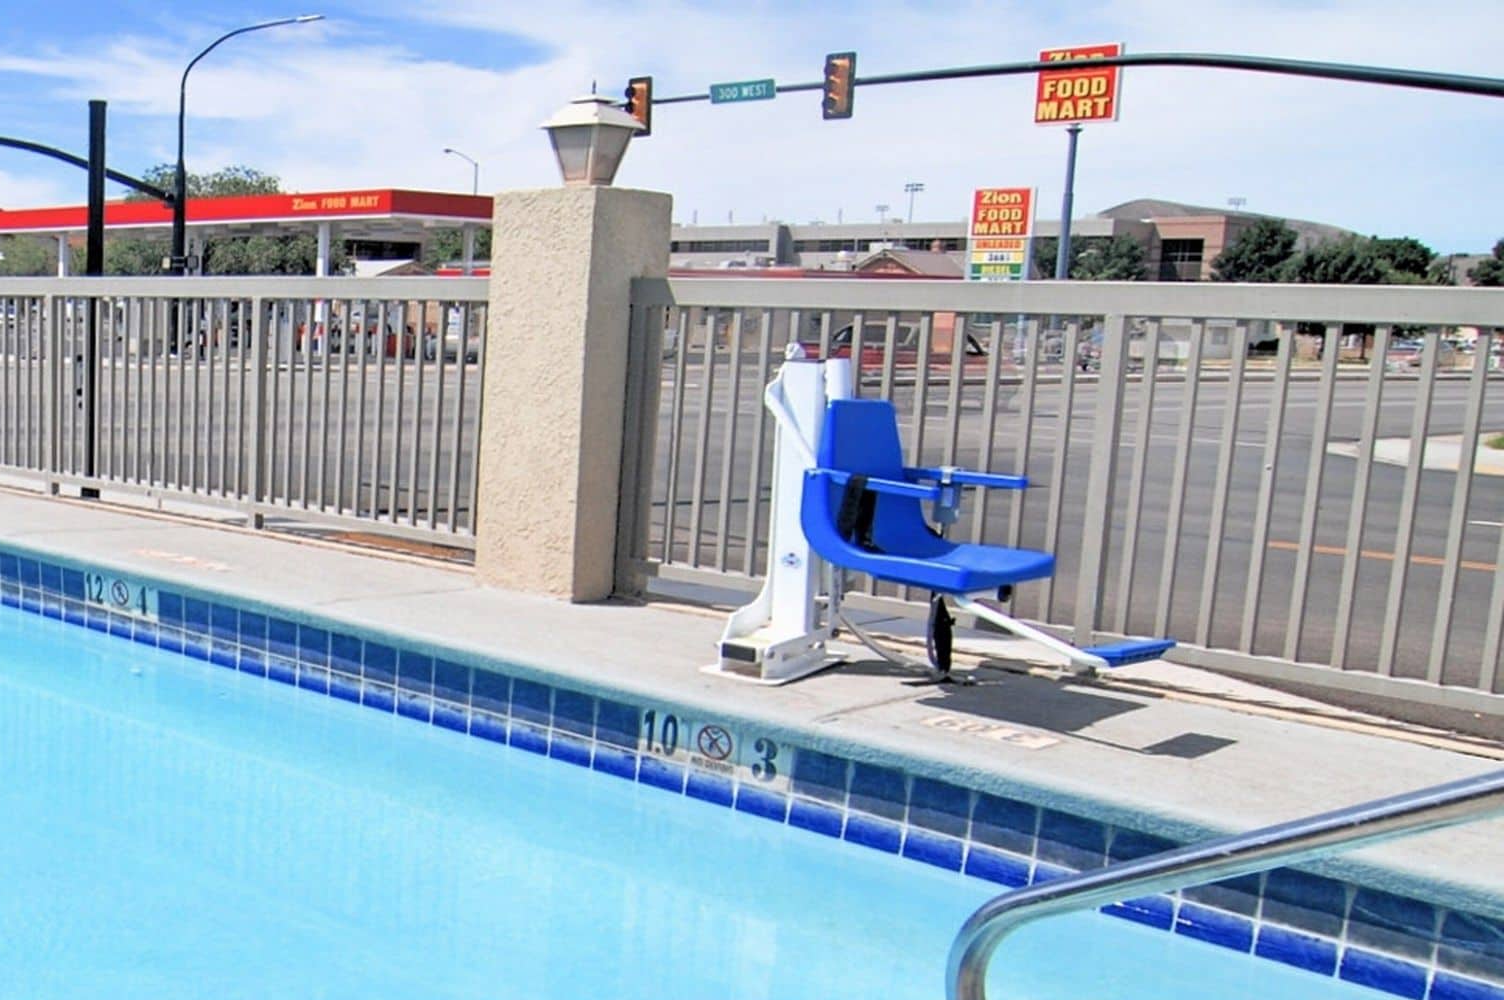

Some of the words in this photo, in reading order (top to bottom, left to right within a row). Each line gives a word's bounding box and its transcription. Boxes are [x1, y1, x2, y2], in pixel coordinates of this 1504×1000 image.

[741, 83, 767, 98] WEST
[1043, 76, 1107, 100] FOOD
[1037, 97, 1110, 120] MART
[321, 197, 347, 209] FOOD
[350, 195, 380, 208] MART
[981, 191, 1022, 205] Zion
[978, 209, 1022, 222] FOOD
[974, 221, 1025, 235] MART
[645, 709, 678, 757] 1.0
[752, 737, 779, 782] 3
